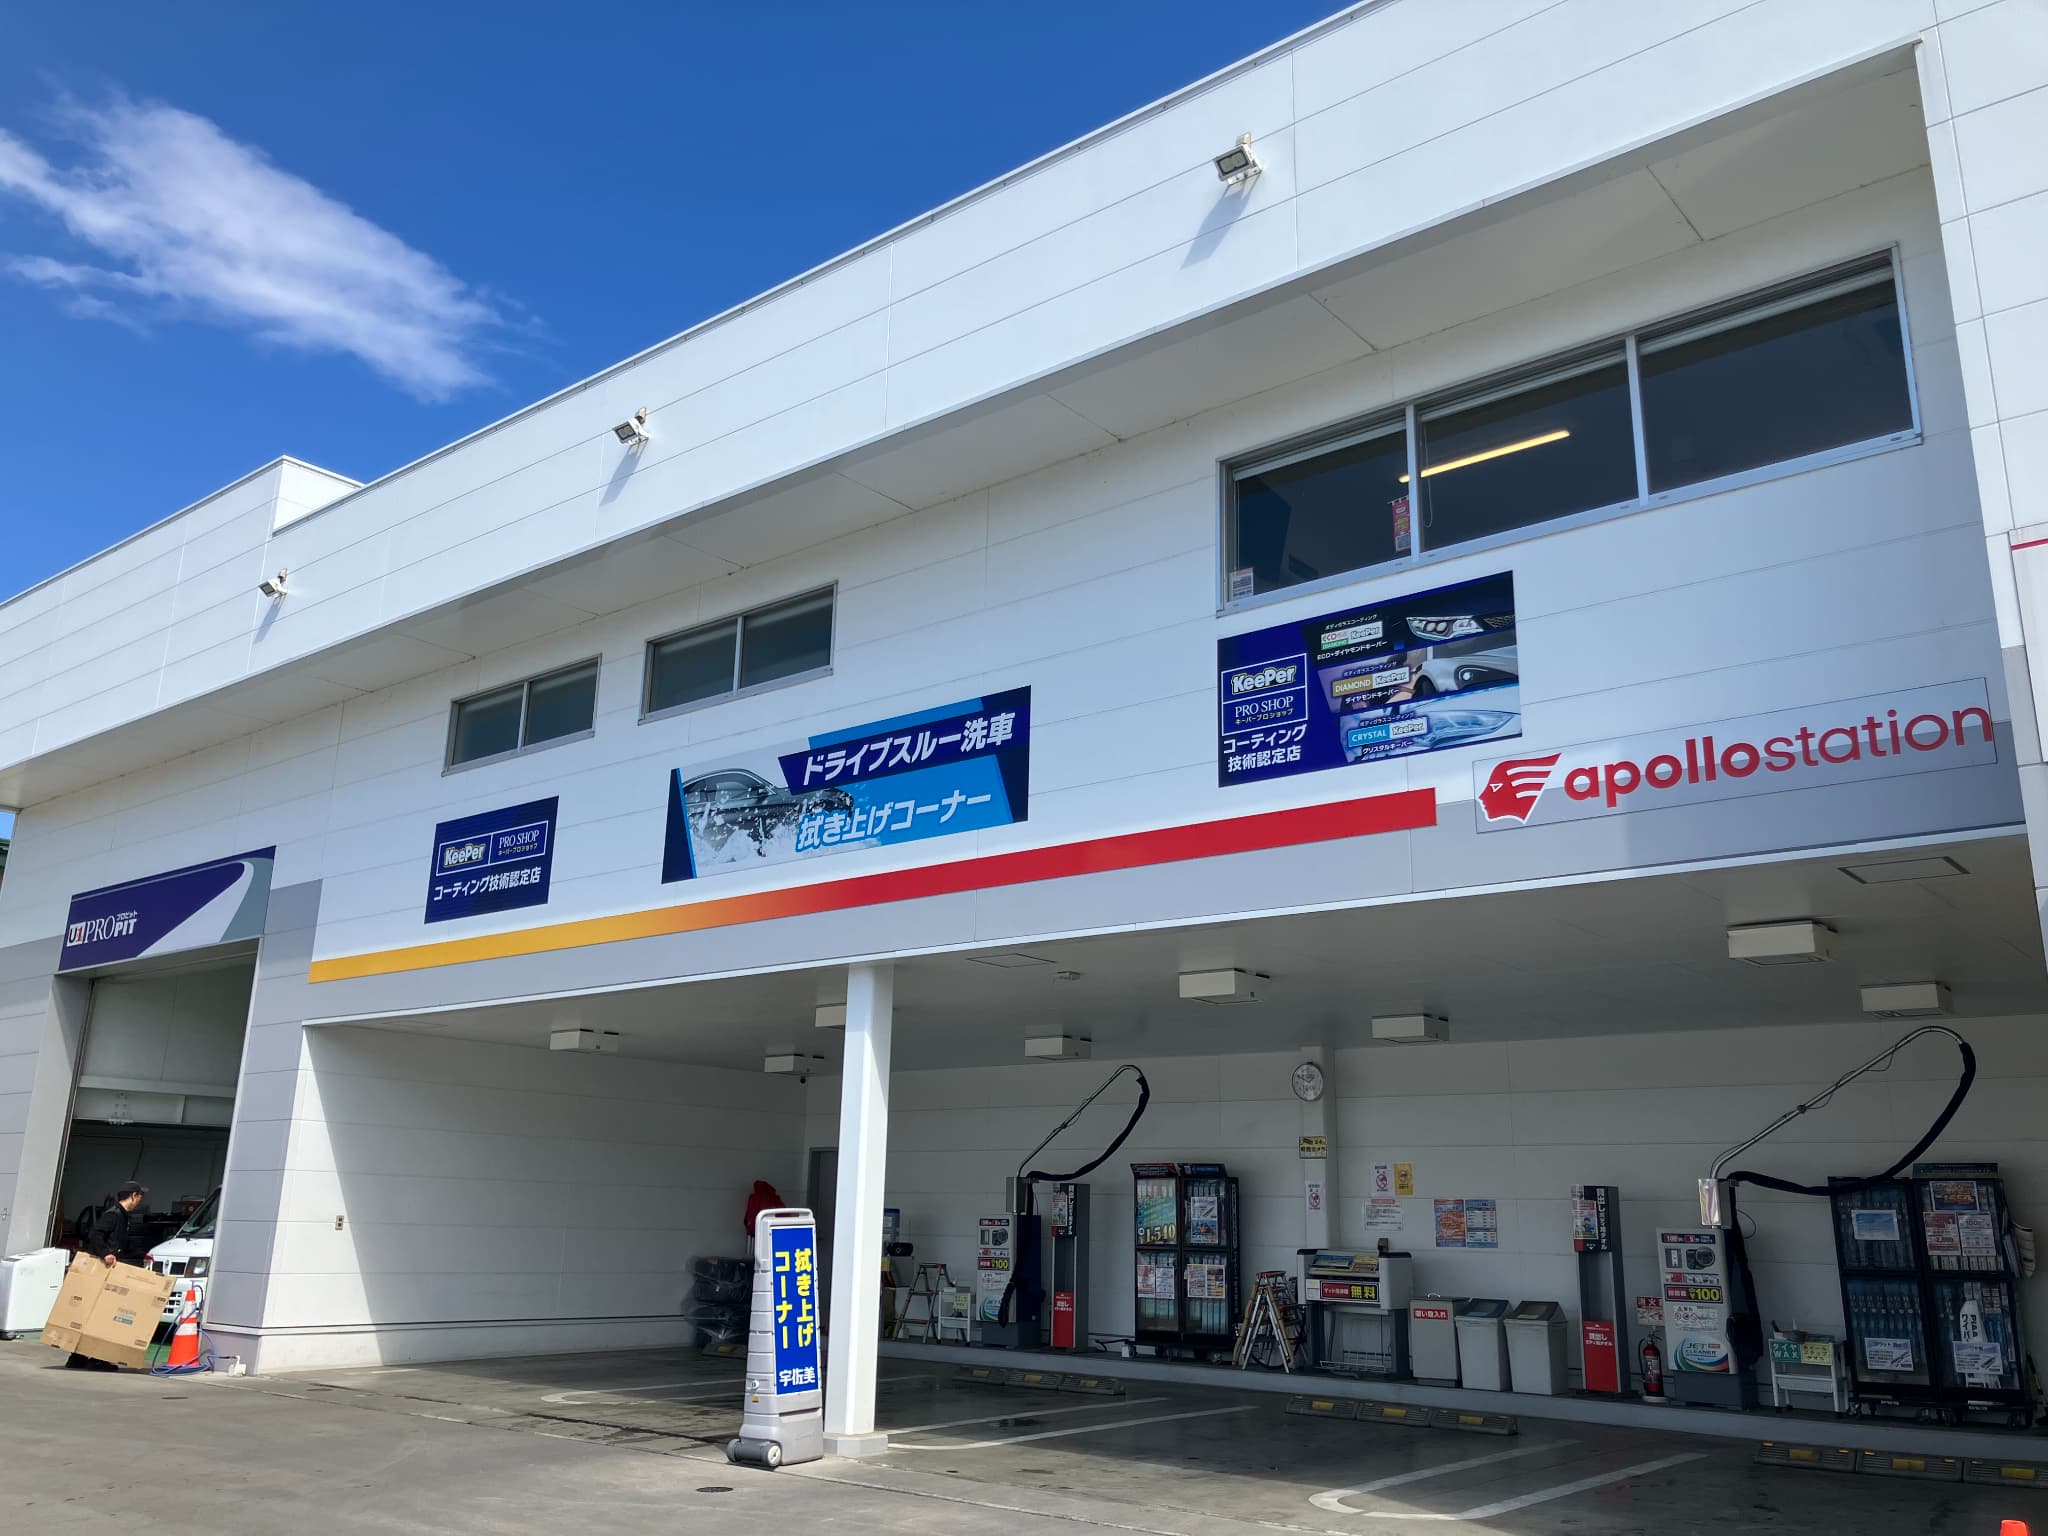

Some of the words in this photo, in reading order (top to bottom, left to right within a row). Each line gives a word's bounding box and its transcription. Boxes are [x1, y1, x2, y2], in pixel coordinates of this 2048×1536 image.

[1231, 664, 1297, 696] KeePer
[1335, 680, 1371, 693] DIAMOND
[1235, 701, 1259, 718] PRO
[1261, 695, 1294, 714] SHOP
[1345, 688, 1399, 704] ダイヤモンドキーパー
[1235, 708, 1293, 725] キーパープロショップ
[1223, 724, 1307, 754] コーティング
[1352, 729, 1386, 742] CRYSTAL
[803, 711, 1016, 787] ドライブスルー洗車
[1227, 745, 1301, 773] 技術認定店
[1362, 741, 1413, 755] クリスタルキーパー
[1563, 706, 1993, 809] apollostation
[798, 788, 992, 851] 拭き上げコーナー
[499, 834, 515, 849] PRO
[517, 829, 540, 846] SHOP
[444, 844, 486, 868] KeePer
[434, 866, 541, 901] コーティング技術認定店
[775, 1251, 792, 1349] コーナー
[794, 1248, 814, 1347] 拭き上げ
[1351, 1285, 1376, 1299] 無料
[1773, 1350, 1799, 1360] WAX
[778, 1366, 816, 1387] 宇佐美
